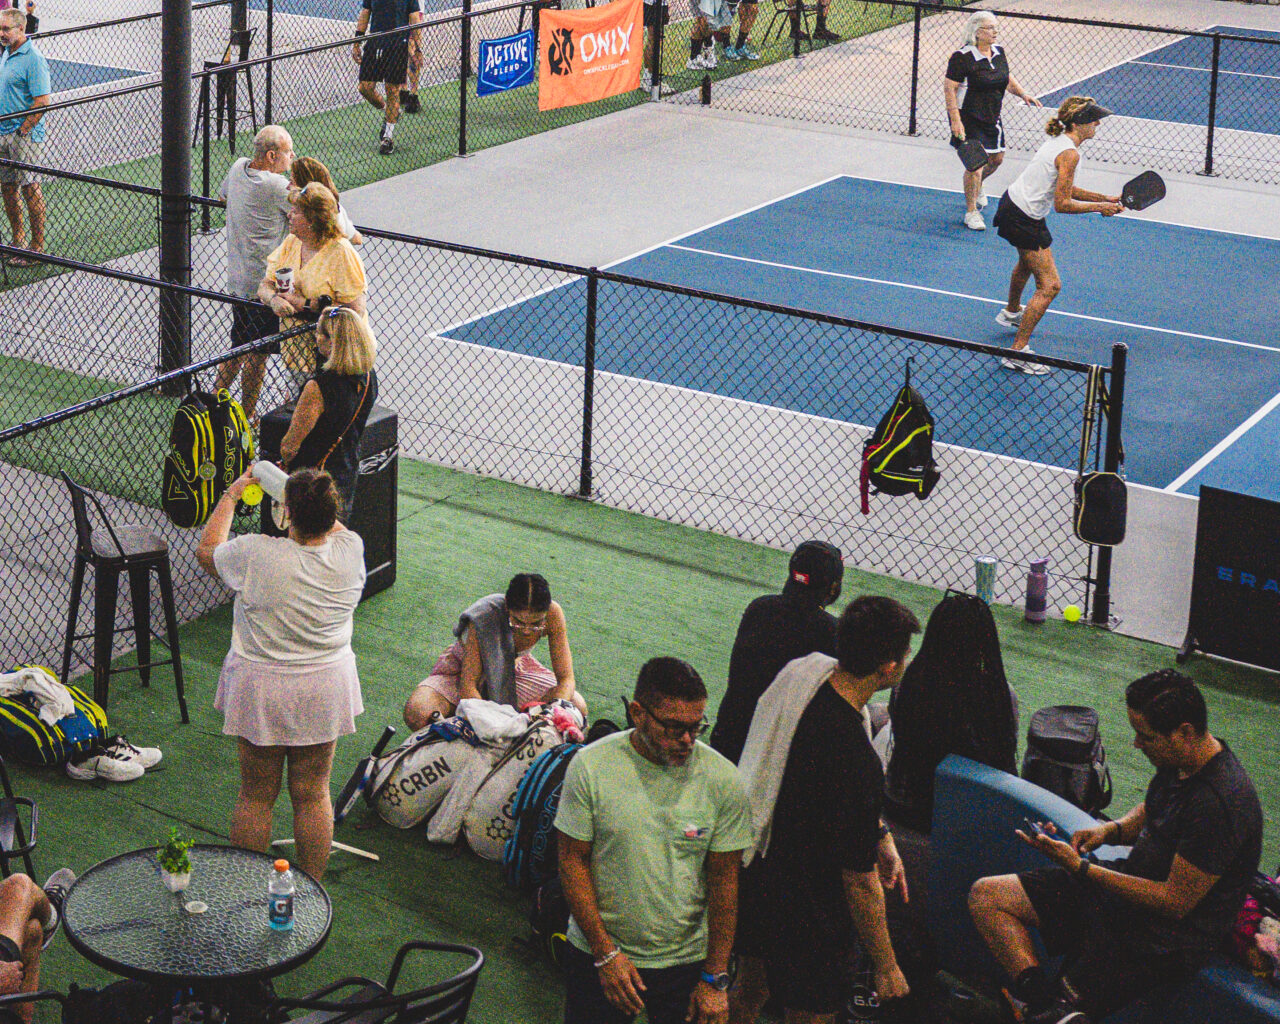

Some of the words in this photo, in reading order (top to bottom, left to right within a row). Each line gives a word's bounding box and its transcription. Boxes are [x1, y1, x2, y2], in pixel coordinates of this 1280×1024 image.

[484, 38, 528, 73] ACTIVE
[579, 22, 634, 63] ONIX
[493, 63, 521, 76] BLEND
[1217, 565, 1280, 593] ERA
[400, 756, 452, 796] CRBN
